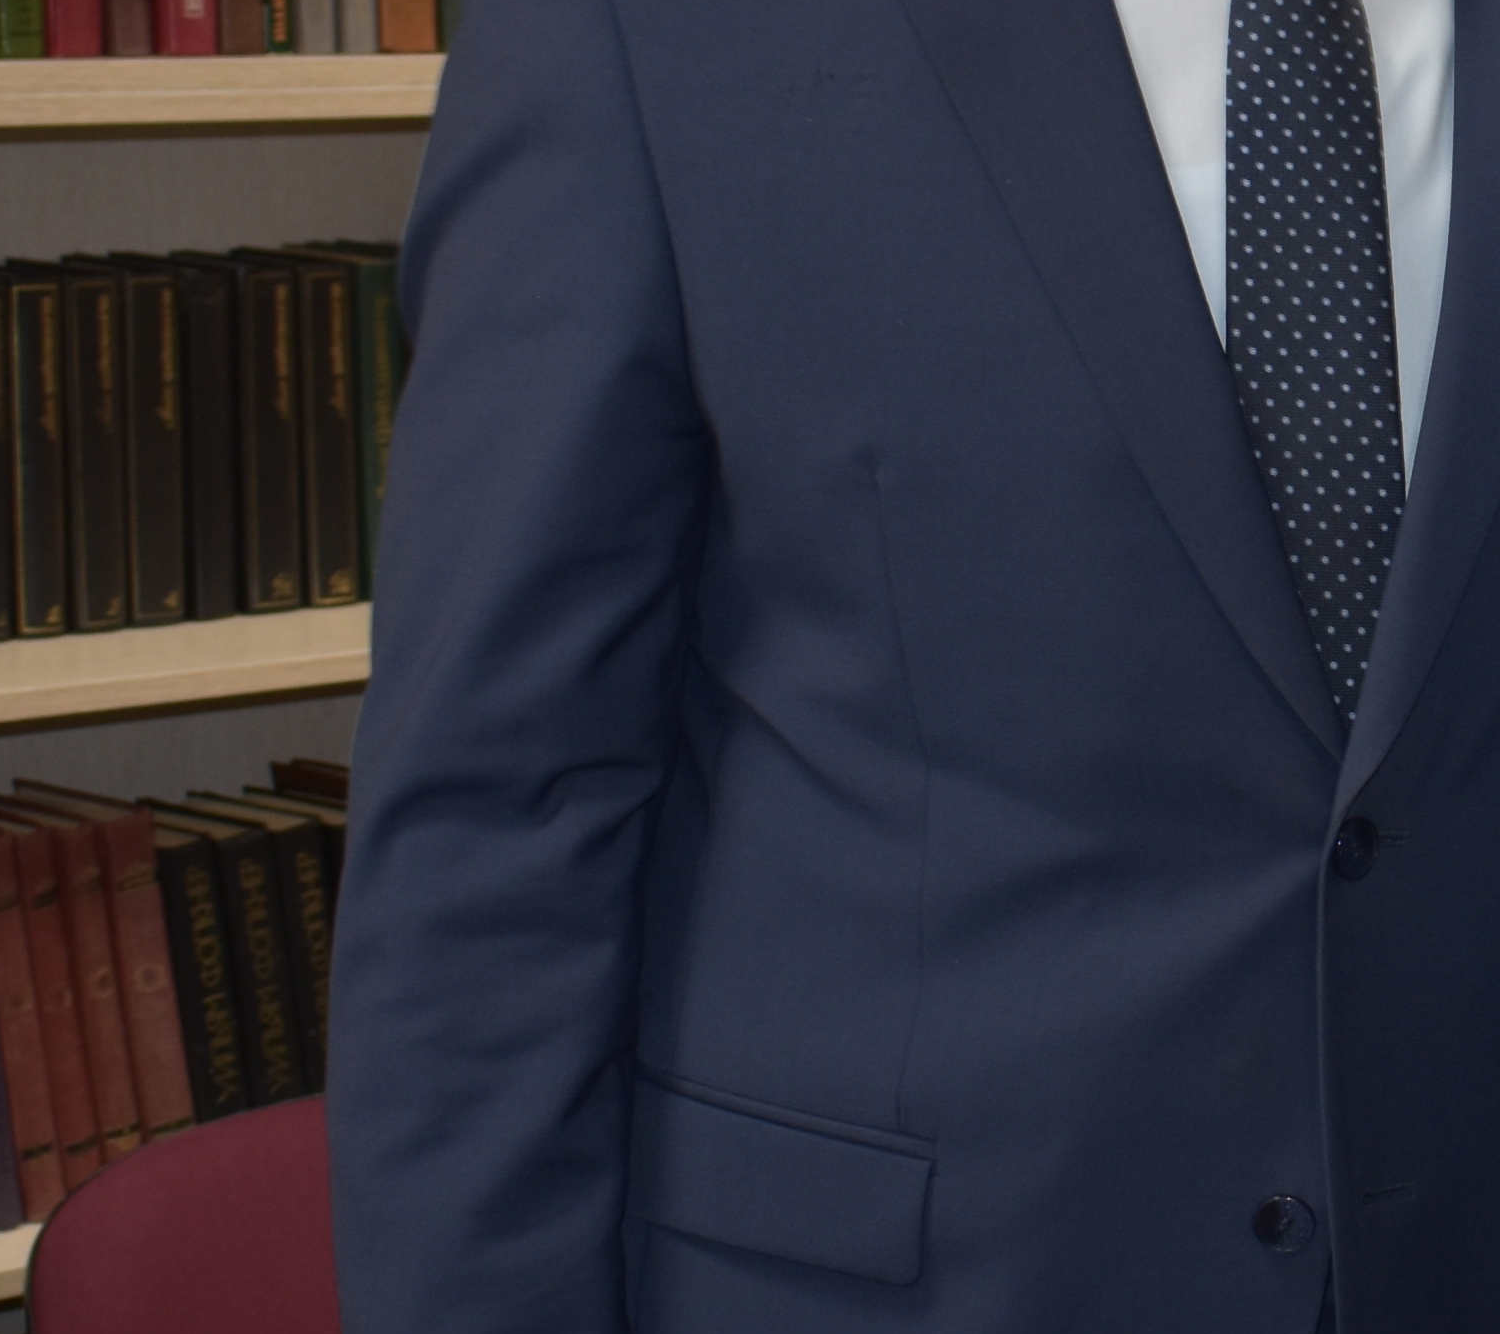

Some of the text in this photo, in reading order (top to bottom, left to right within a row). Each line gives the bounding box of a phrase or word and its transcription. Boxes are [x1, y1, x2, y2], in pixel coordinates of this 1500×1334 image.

[184, 865, 243, 1102] УИЛЬЯМ ФОЛКНЕР
[237, 856, 293, 1094] УИЛЬЯМ ФОЛКНЕР
